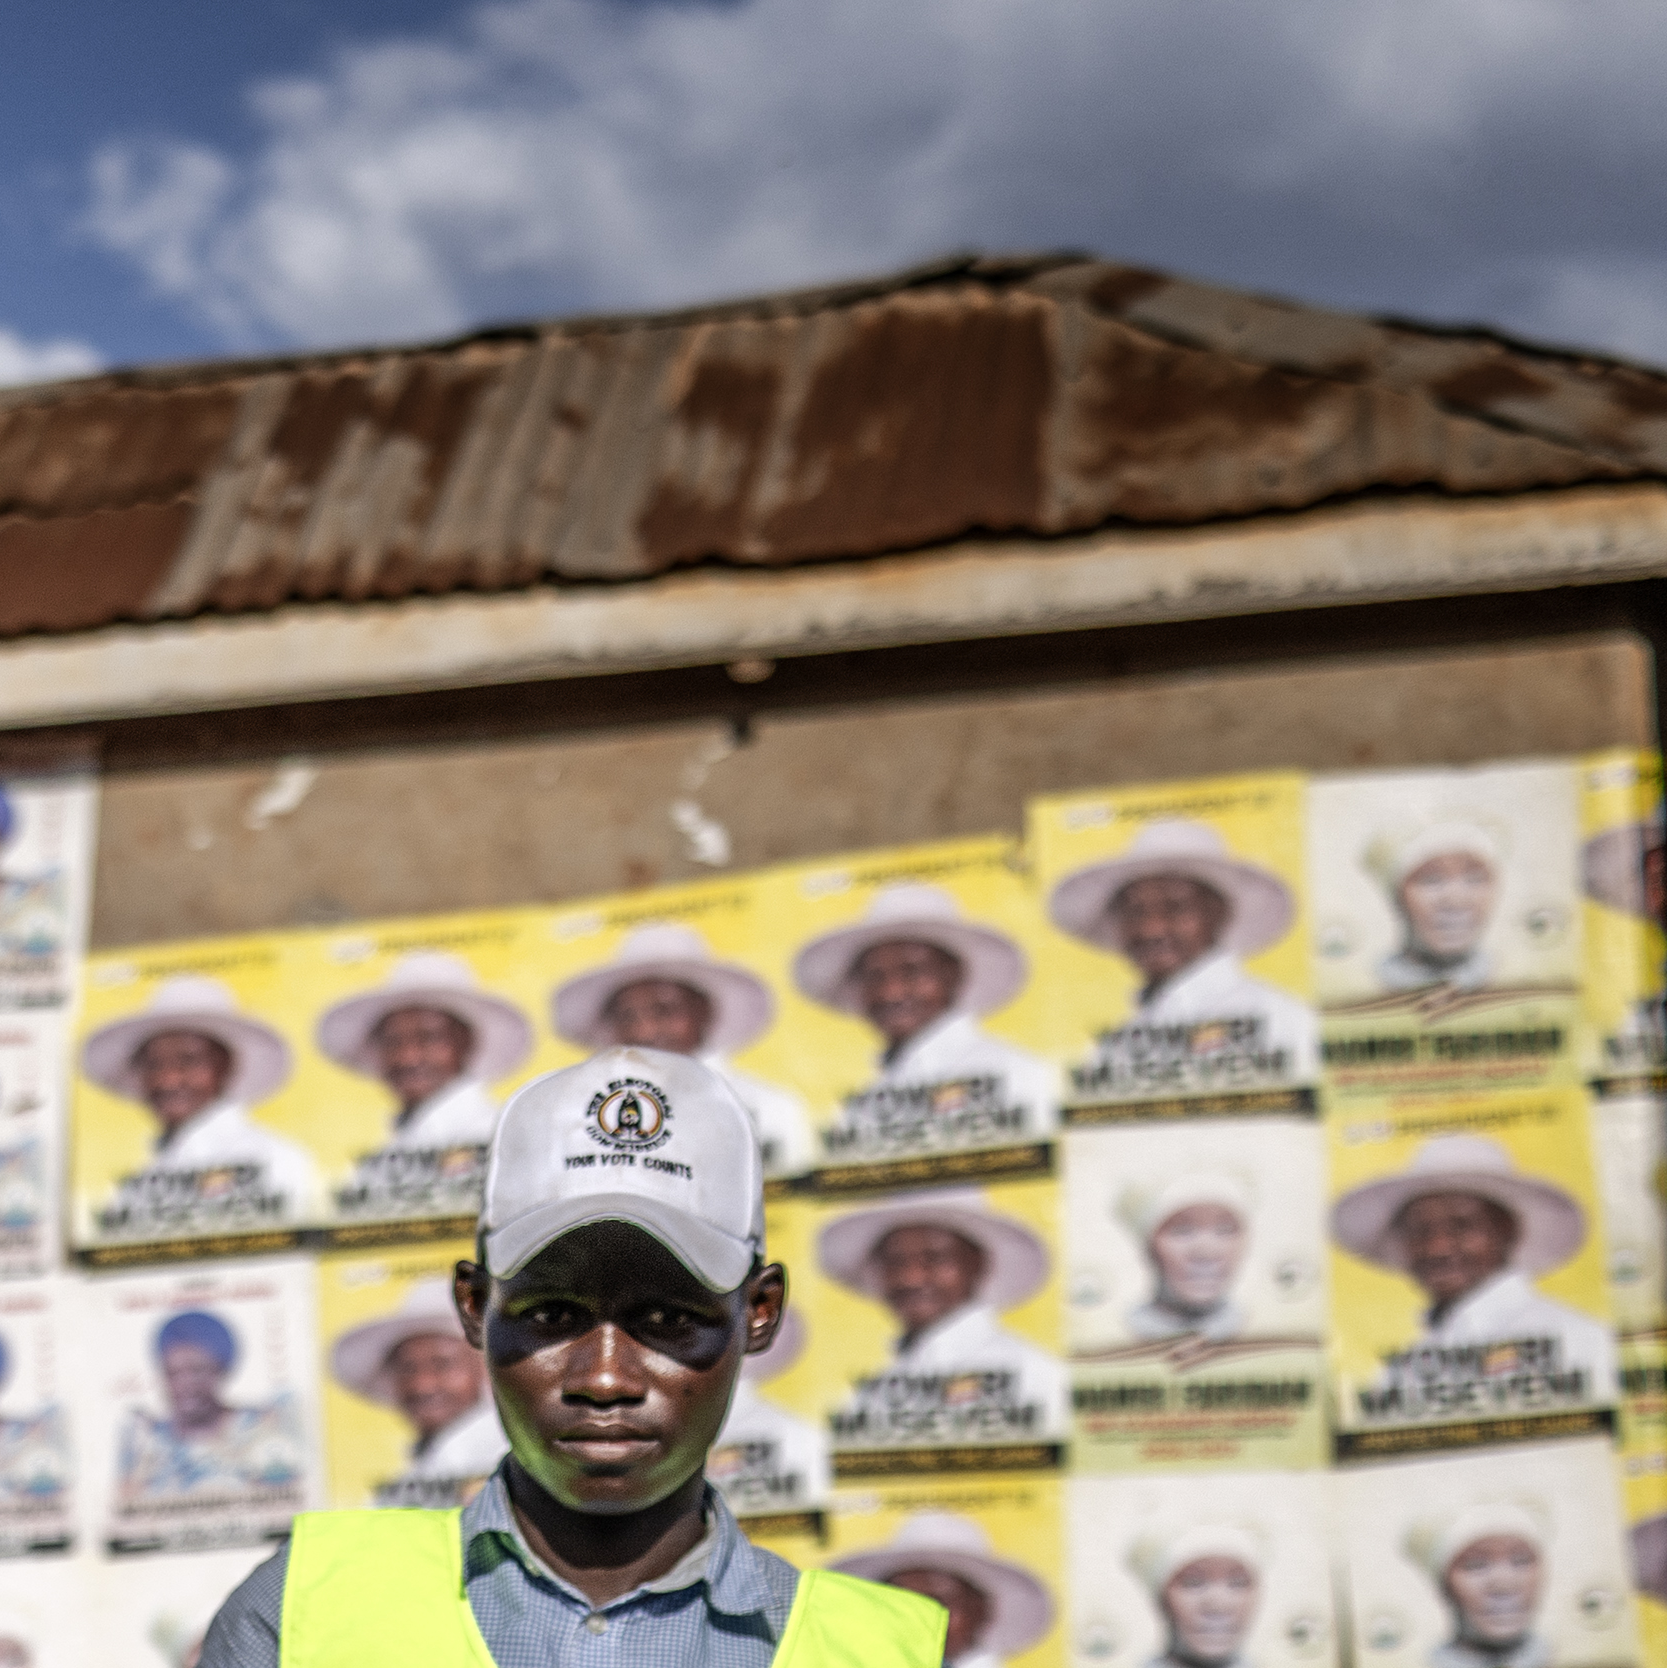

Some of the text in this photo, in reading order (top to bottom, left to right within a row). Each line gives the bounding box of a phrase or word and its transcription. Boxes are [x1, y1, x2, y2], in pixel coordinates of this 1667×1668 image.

[565, 1153, 693, 1180] YOUR VOTE COUNTS
